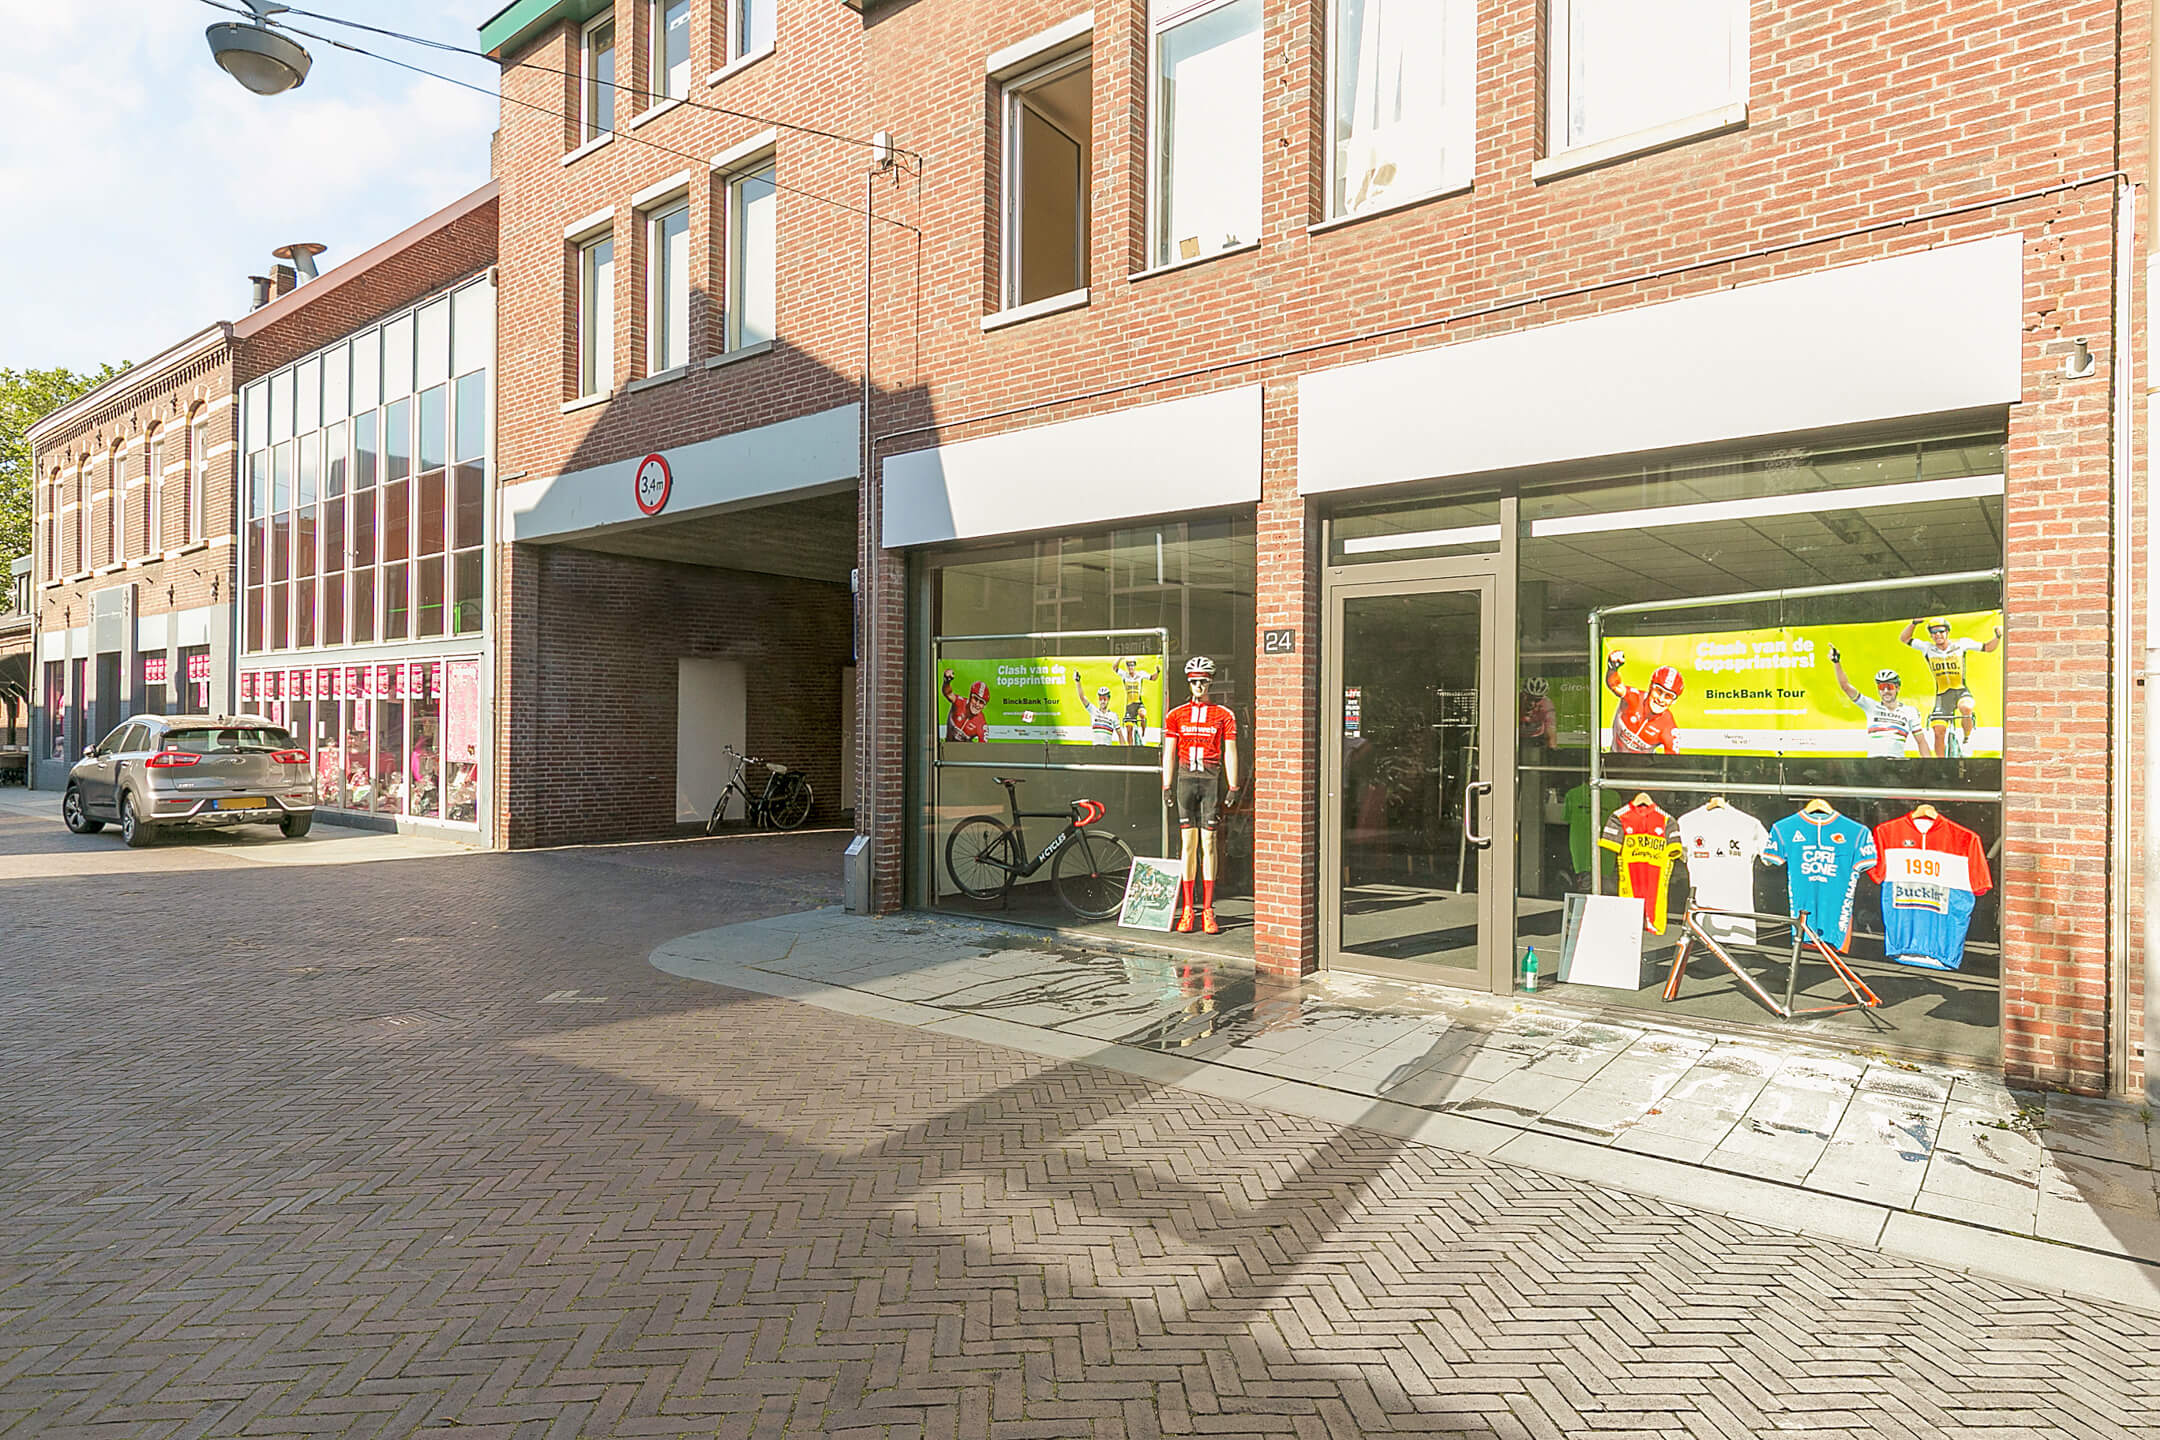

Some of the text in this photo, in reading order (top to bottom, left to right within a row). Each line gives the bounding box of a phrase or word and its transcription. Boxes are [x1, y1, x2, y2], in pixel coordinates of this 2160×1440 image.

[1265, 631, 1292, 651] 24
[1696, 637, 1815, 656] Clash van de
[998, 664, 1066, 675] Clash van de
[1694, 653, 1815, 674] topsprinters!
[997, 675, 1067, 687] topsprinters!
[1706, 688, 1806, 699] BinckBank Tour
[1044, 697, 1060, 705] Tour
[1181, 725, 1217, 734] Sunweb
[1905, 858, 1941, 877] 1990
